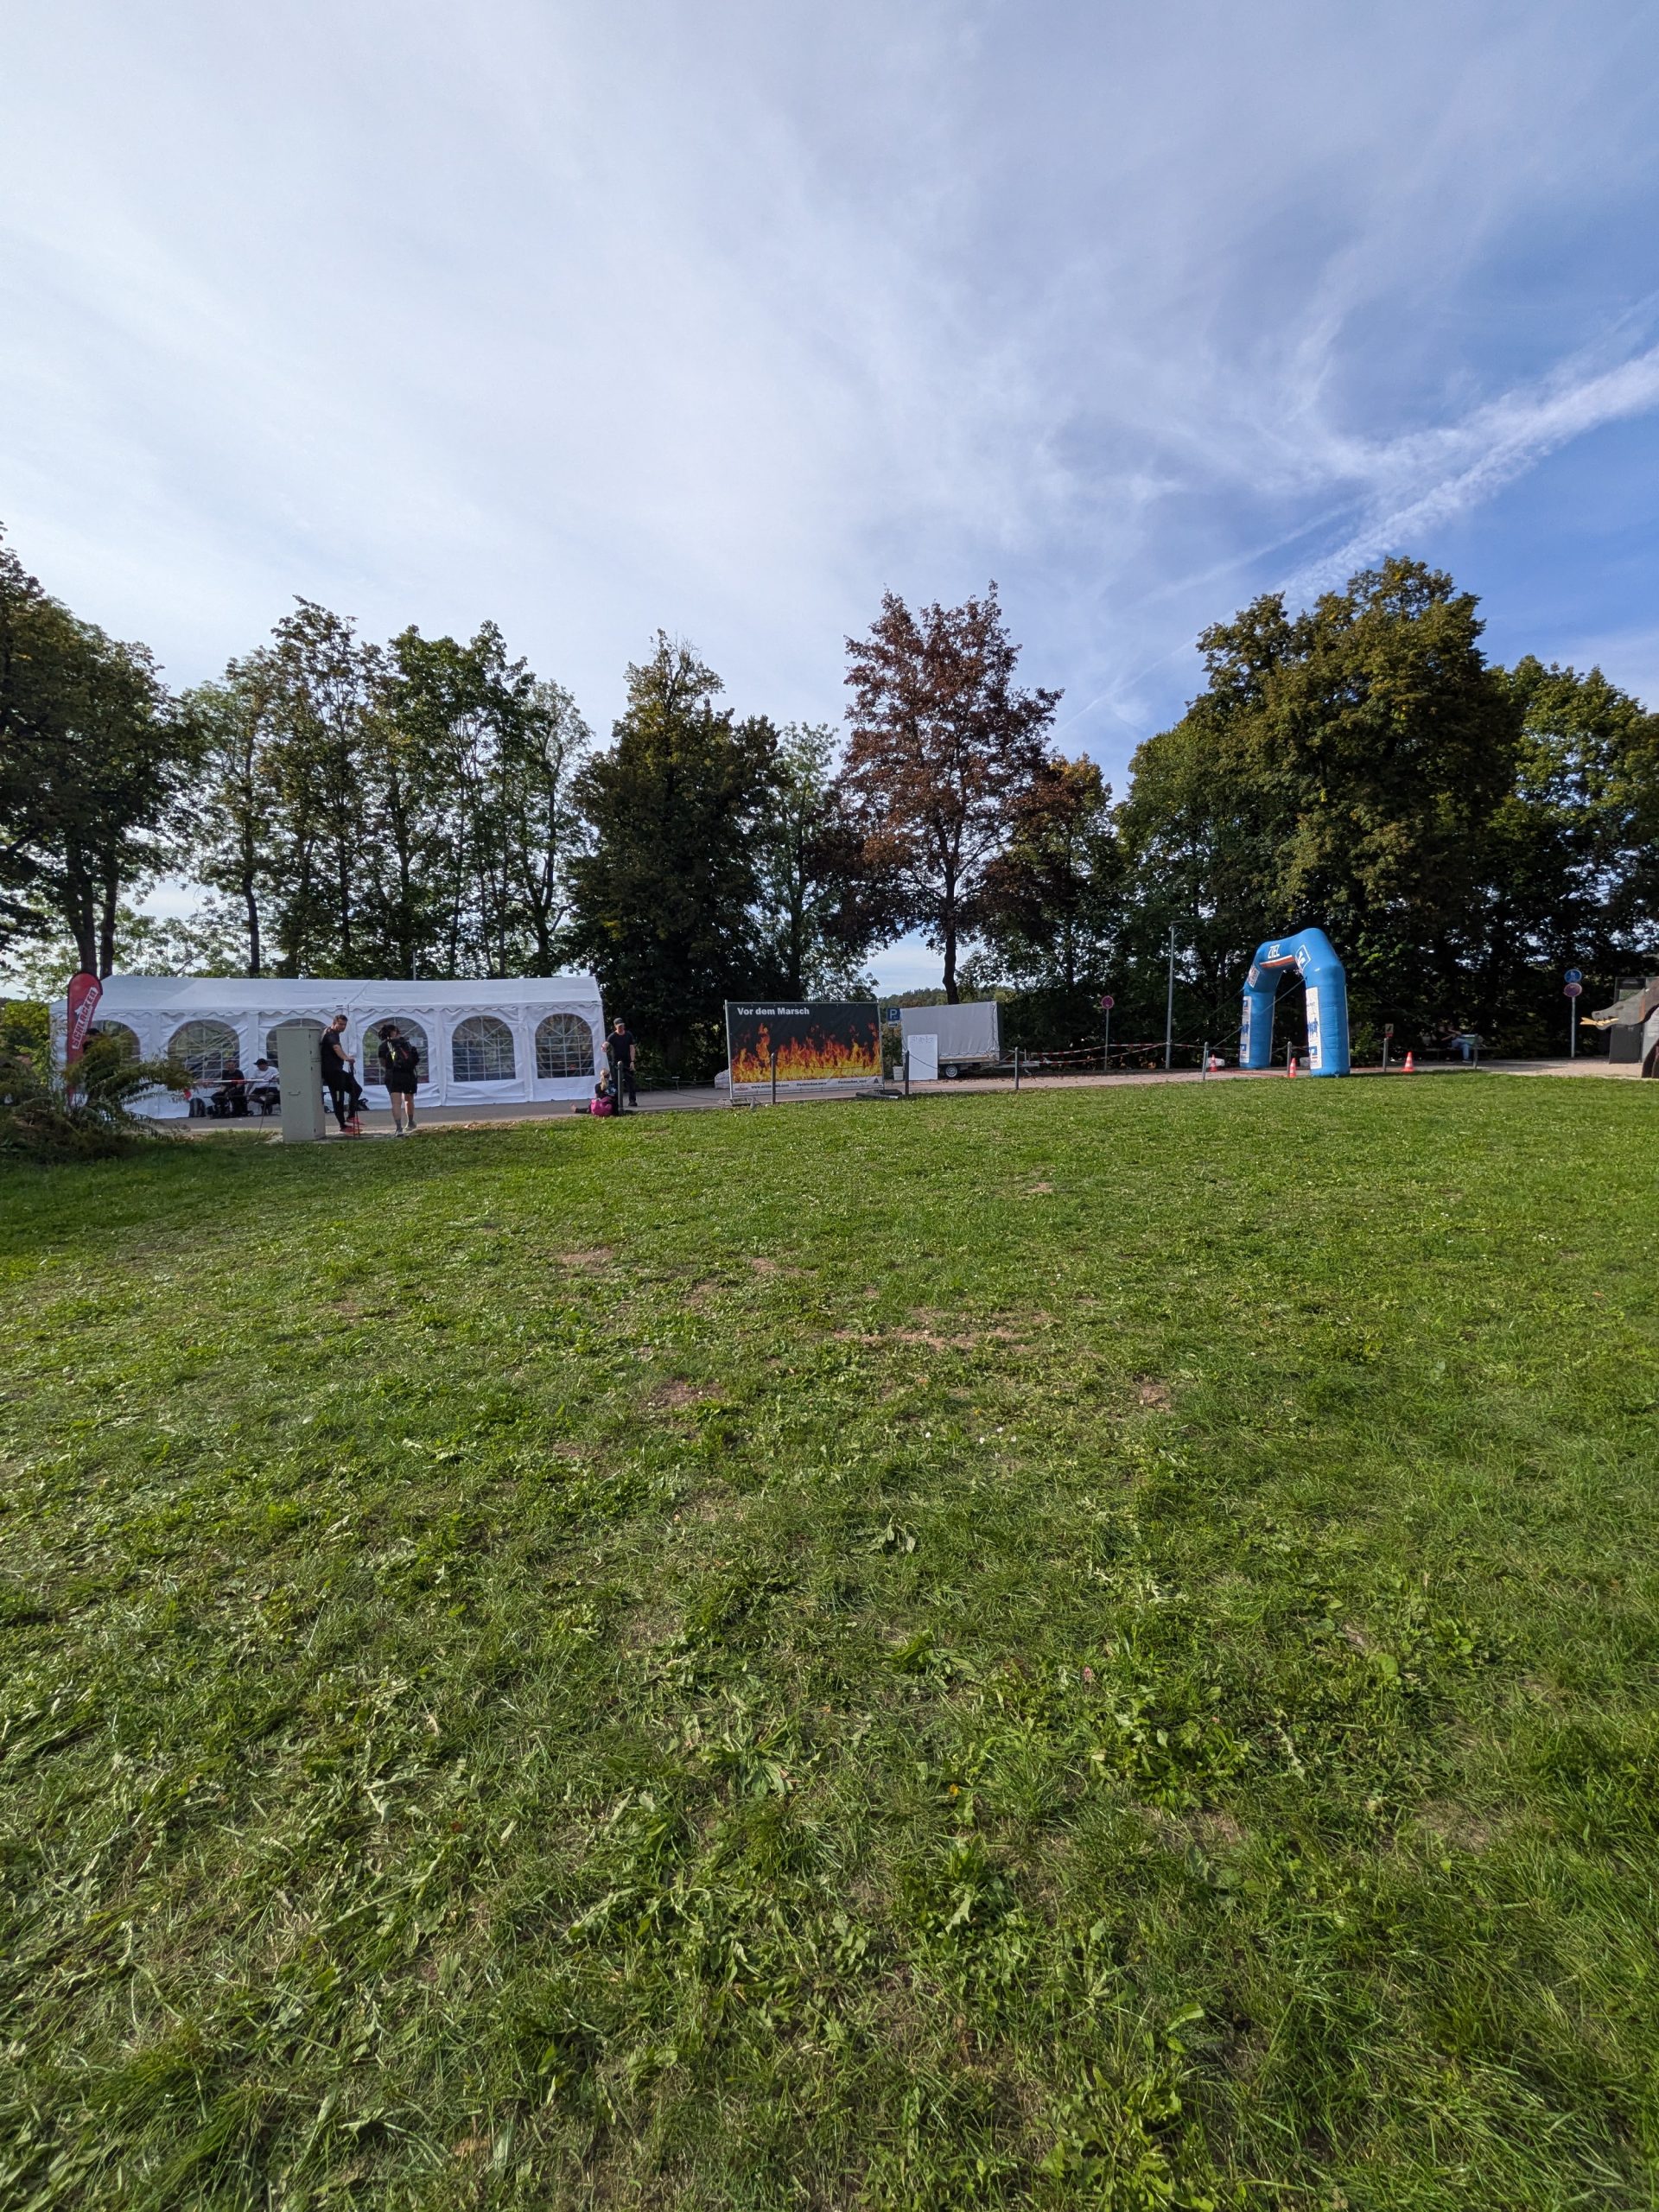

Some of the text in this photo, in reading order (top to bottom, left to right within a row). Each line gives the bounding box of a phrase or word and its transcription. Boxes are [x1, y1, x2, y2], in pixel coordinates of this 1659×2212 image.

[1268, 944, 1281, 959] ZIEL
[737, 1007, 810, 1015] Vor dem Marsch
[889, 1008, 898, 1020] P
